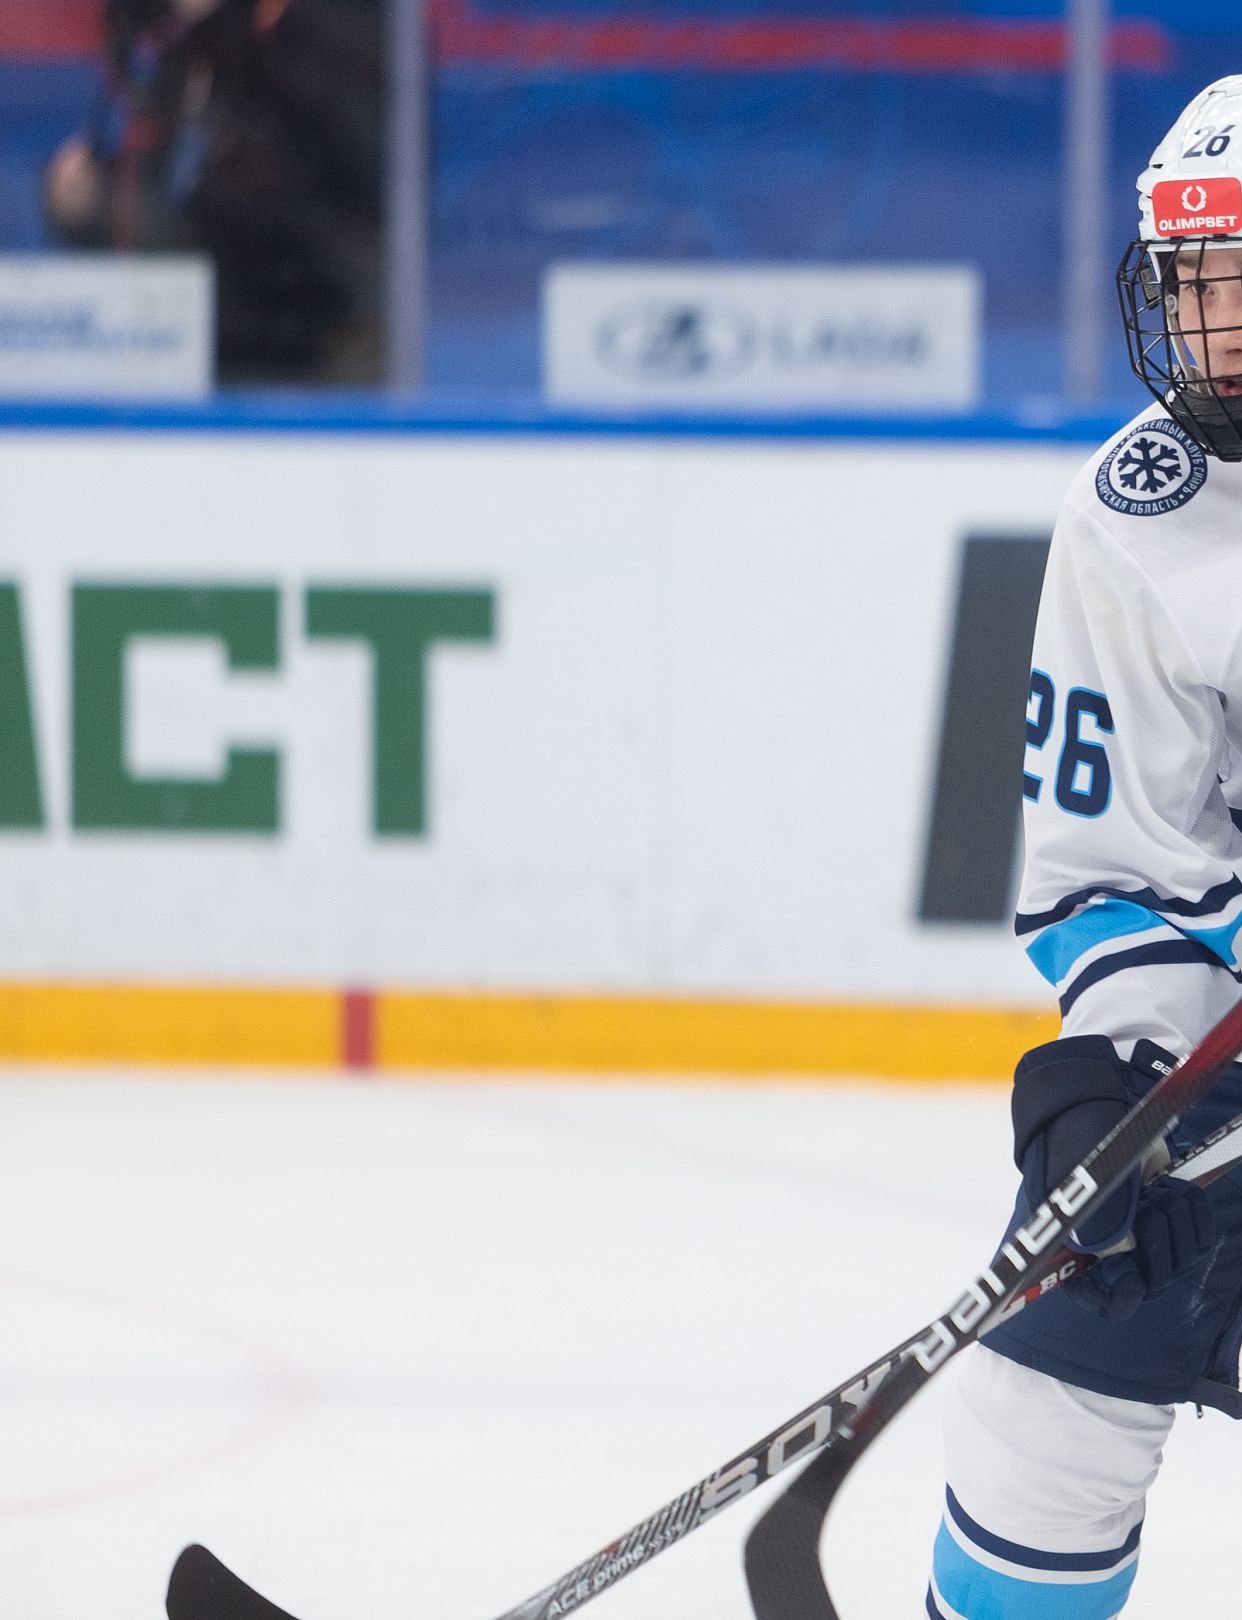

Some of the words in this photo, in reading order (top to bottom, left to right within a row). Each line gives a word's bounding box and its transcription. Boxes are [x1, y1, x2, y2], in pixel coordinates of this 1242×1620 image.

[1182, 123, 1236, 159] 26
[1158, 215, 1238, 232] OLIMPBET
[1129, 498, 1179, 515] ОБЛАСТЬ
[0, 580, 498, 840] CT
[547, 1578, 591, 1617] ACE
